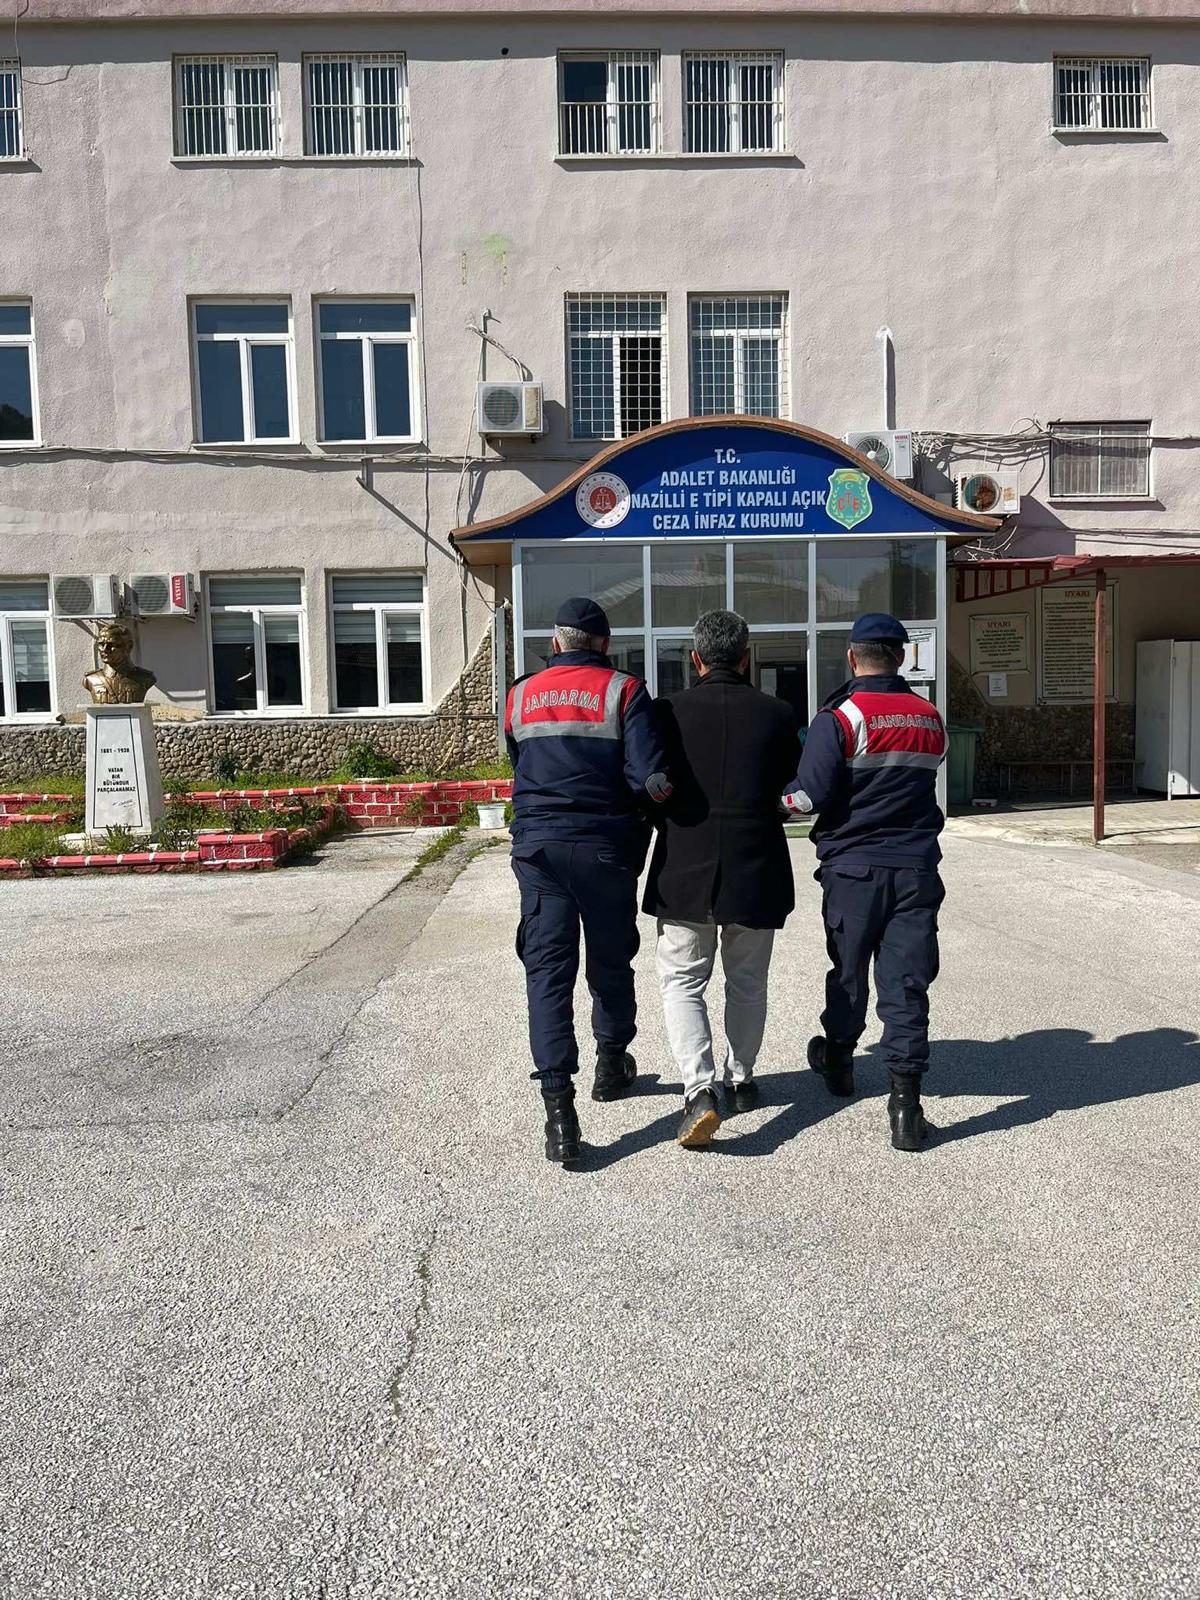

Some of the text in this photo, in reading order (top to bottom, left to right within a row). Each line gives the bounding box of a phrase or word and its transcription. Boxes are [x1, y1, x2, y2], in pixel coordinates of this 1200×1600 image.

[714, 449, 741, 464] T.C.
[659, 466, 796, 486] ADALET BAKANLIĞI
[631, 489, 826, 510] NAZİLLİ E TİPİ KAPALI AÇIK
[652, 511, 804, 530] CEZA İNFAZ KURUMU
[525, 689, 600, 713] JANDARMA
[870, 713, 941, 731] JANDARMA
